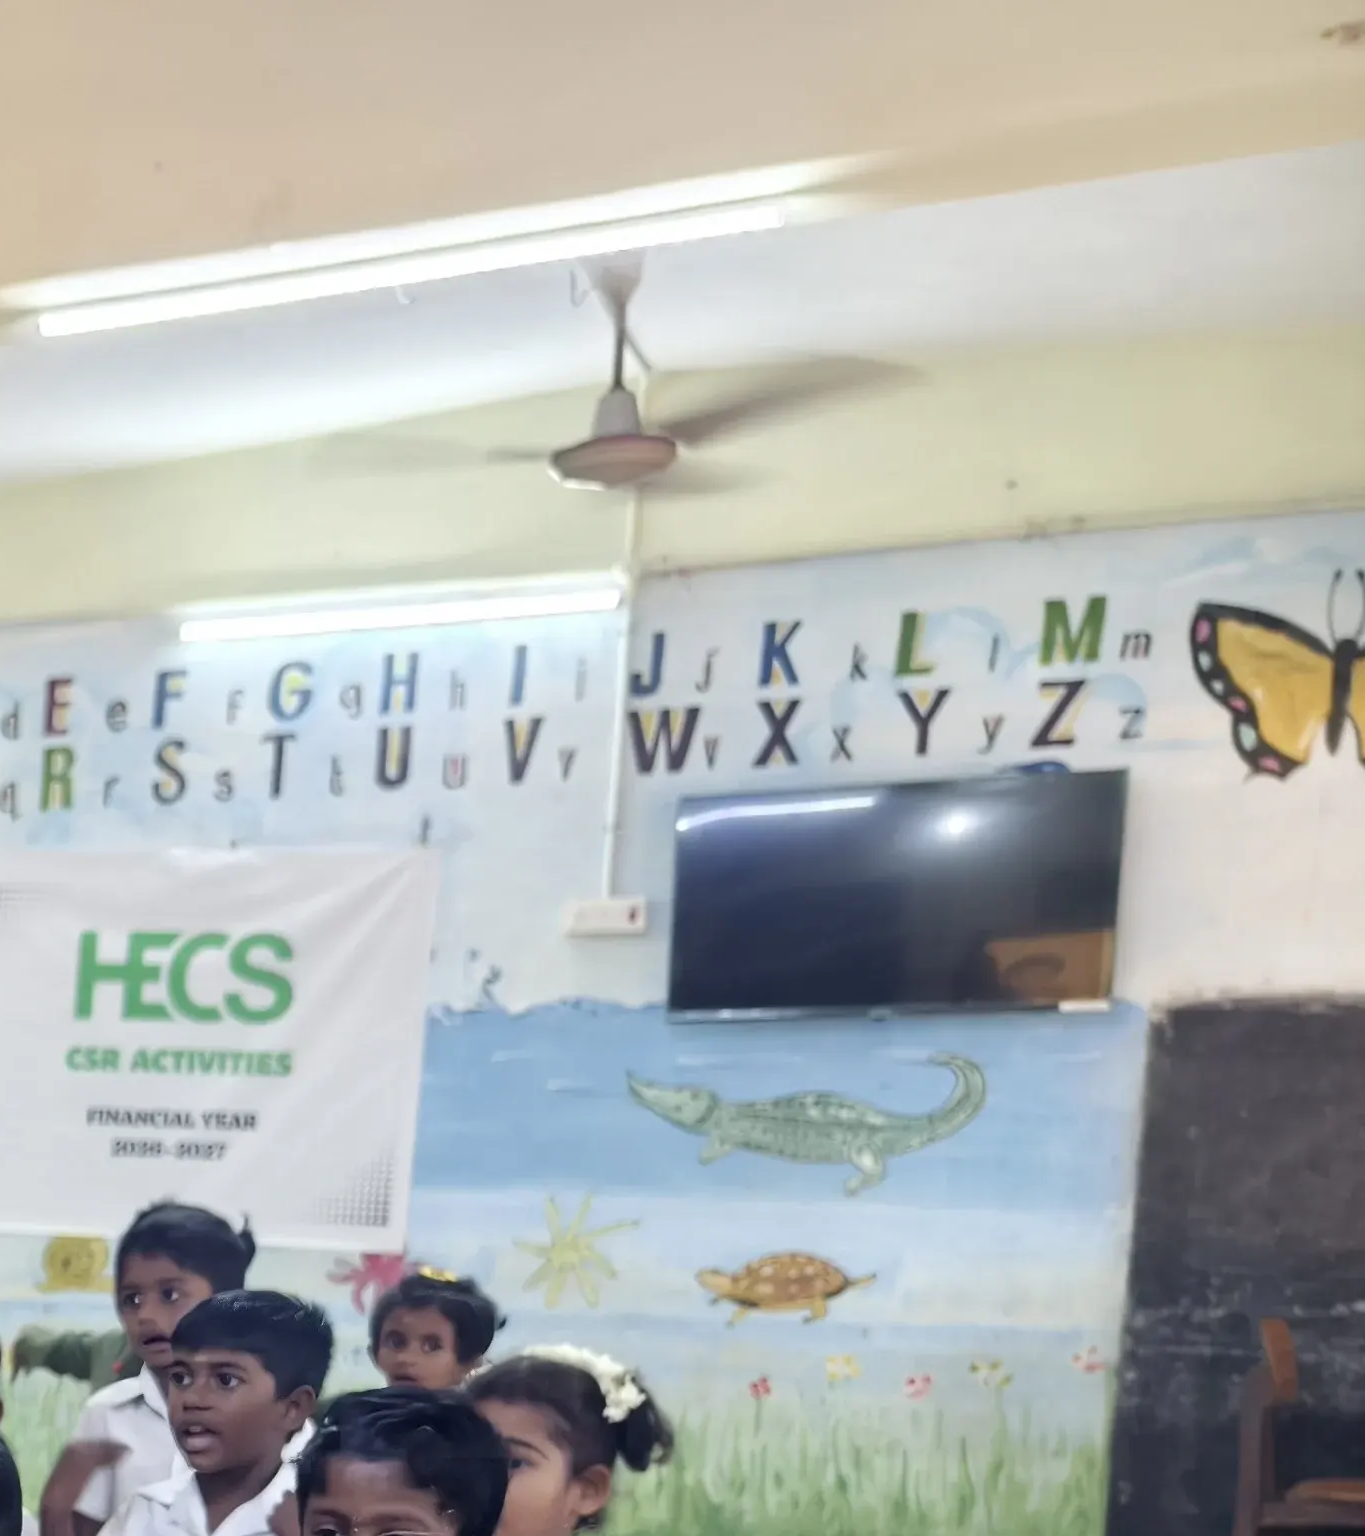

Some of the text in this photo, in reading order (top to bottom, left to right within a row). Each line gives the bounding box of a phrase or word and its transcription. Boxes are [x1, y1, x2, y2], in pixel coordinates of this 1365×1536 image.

[43, 676, 75, 738] E
[105, 698, 129, 733] e
[151, 668, 188, 730] F
[269, 660, 314, 722] G
[339, 682, 363, 720] g
[379, 651, 419, 715] H
[508, 644, 528, 707] I
[630, 631, 666, 698] J
[758, 619, 803, 689] K
[849, 642, 868, 682] k
[895, 610, 936, 677] L
[1039, 595, 1108, 668] M
[1119, 629, 1154, 662] m
[40, 747, 75, 812] R
[151, 738, 187, 806] S
[262, 733, 297, 799] T
[374, 726, 412, 791] U
[505, 716, 545, 785] V
[629, 705, 702, 775] W
[752, 699, 802, 768] X
[898, 687, 952, 755] Y
[1031, 678, 1089, 748] Z
[73, 929, 295, 1024] HECS
[65, 1046, 293, 1077] CSR ACTIVITIES
[86, 1106, 258, 1132] FINANCIAL YEAR
